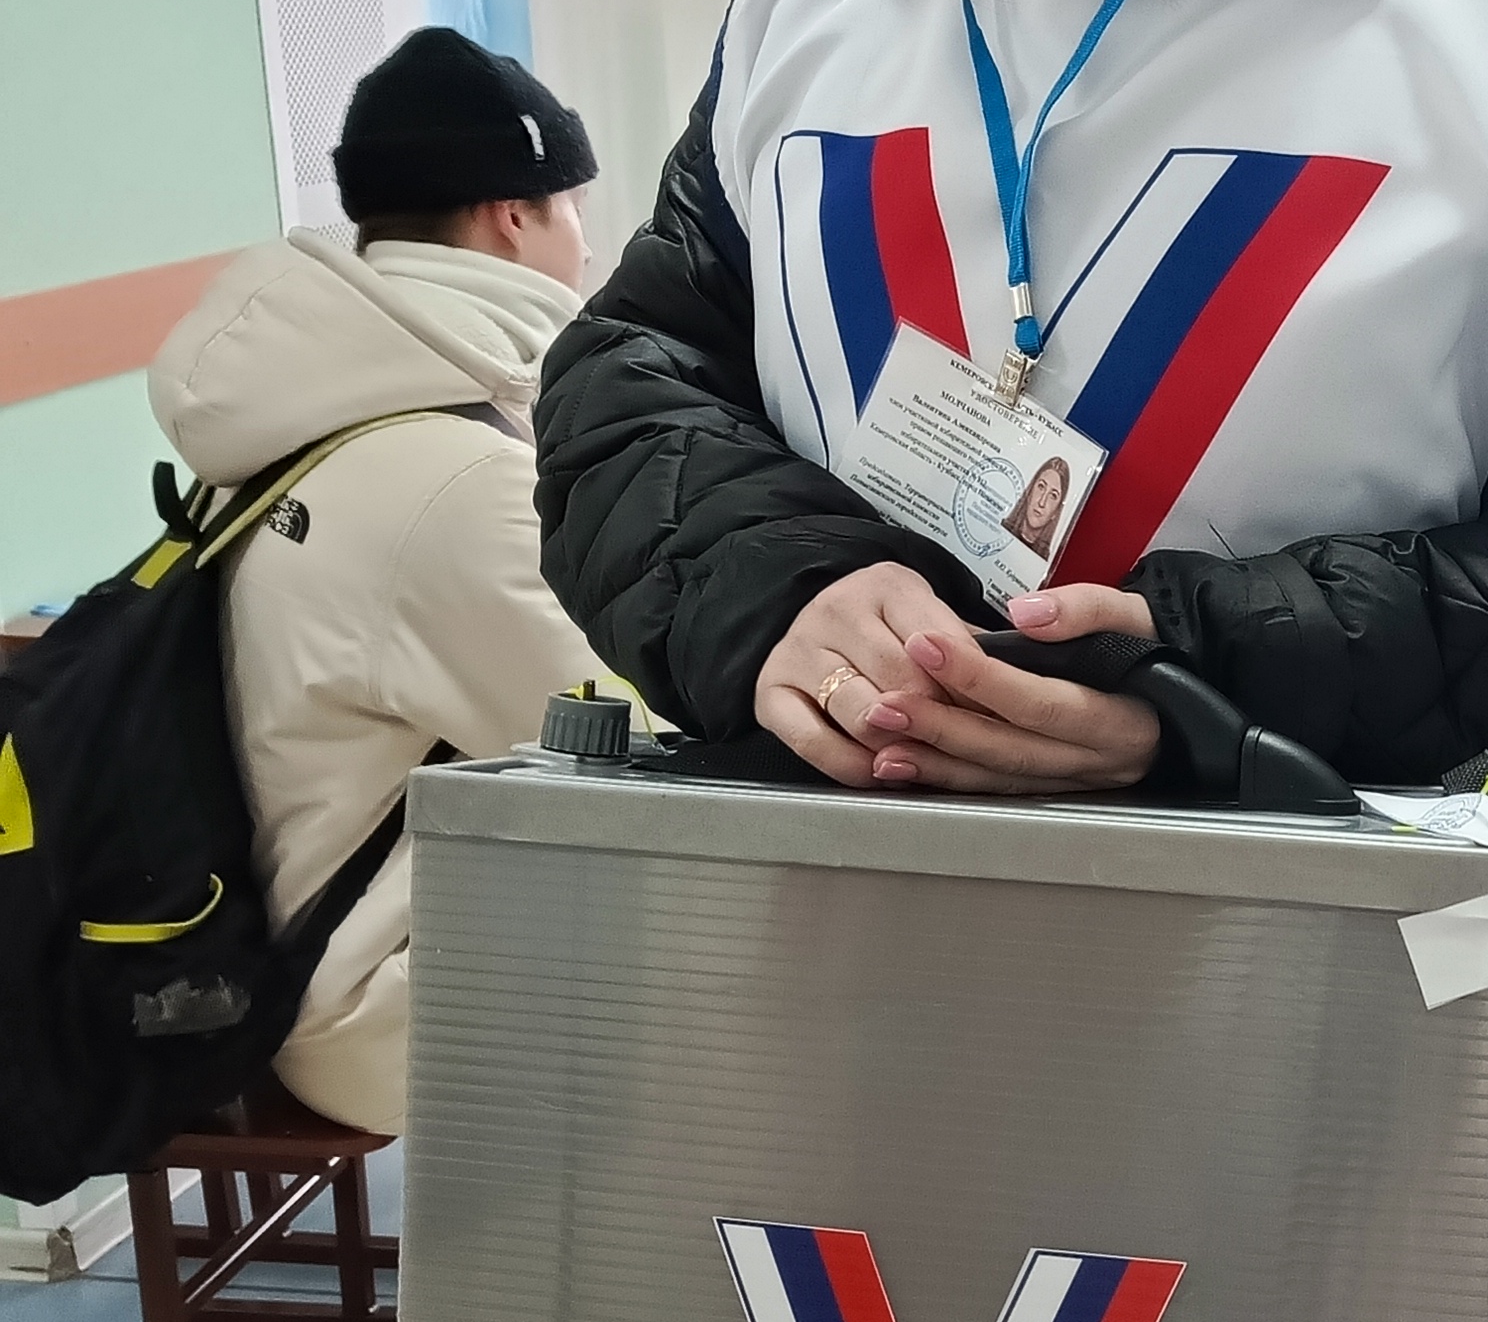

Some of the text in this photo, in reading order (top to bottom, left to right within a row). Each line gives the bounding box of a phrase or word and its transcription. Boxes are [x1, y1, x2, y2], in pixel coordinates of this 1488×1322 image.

[949, 358, 994, 391] КЕМЕРОВСК
[912, 393, 952, 423] Валентина
[939, 389, 992, 427] МОЛЧАНОВА
